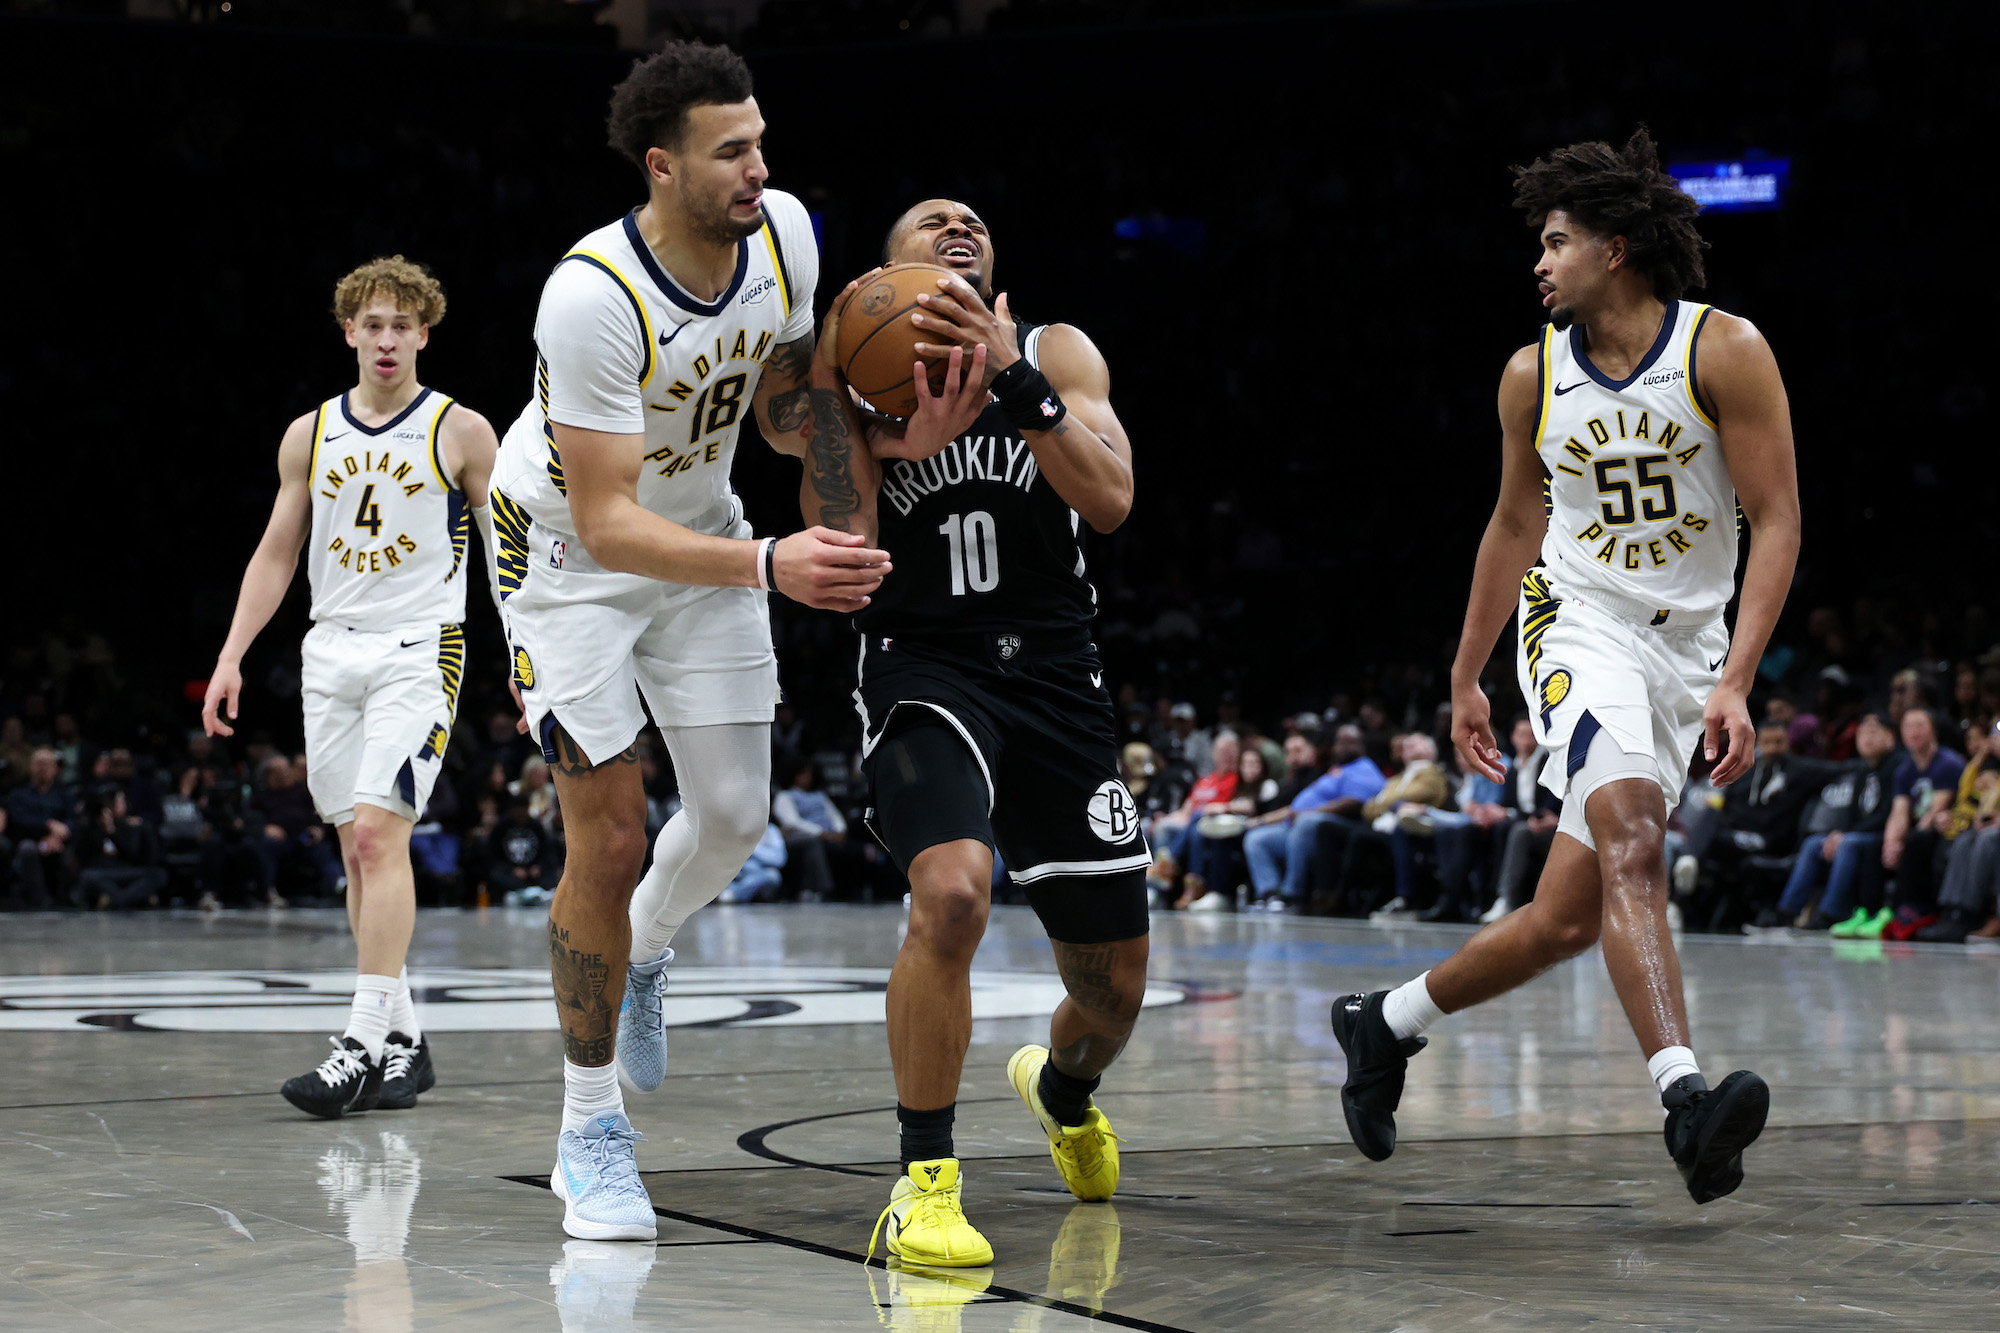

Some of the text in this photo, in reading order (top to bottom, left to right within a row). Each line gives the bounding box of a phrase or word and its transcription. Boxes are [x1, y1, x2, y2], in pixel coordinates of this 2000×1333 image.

[741, 277, 776, 305] LUCAS OIL
[648, 328, 771, 412] INDIAN
[1643, 370, 1685, 385] LUCAS OIL
[689, 372, 747, 446] 18
[393, 432, 414, 440] LUCAS
[643, 438, 729, 478] PACE
[1556, 410, 1703, 477] INDIANA
[321, 451, 425, 500] INDIANA
[882, 436, 1038, 516] BROOKLYN
[1594, 455, 1677, 525] 55
[354, 484, 382, 537] 4
[328, 533, 417, 573] PACERS
[939, 511, 999, 596] 10
[1577, 512, 1710, 570] PACERS
[998, 636, 1019, 647] NETS
[570, 949, 602, 966] THE
